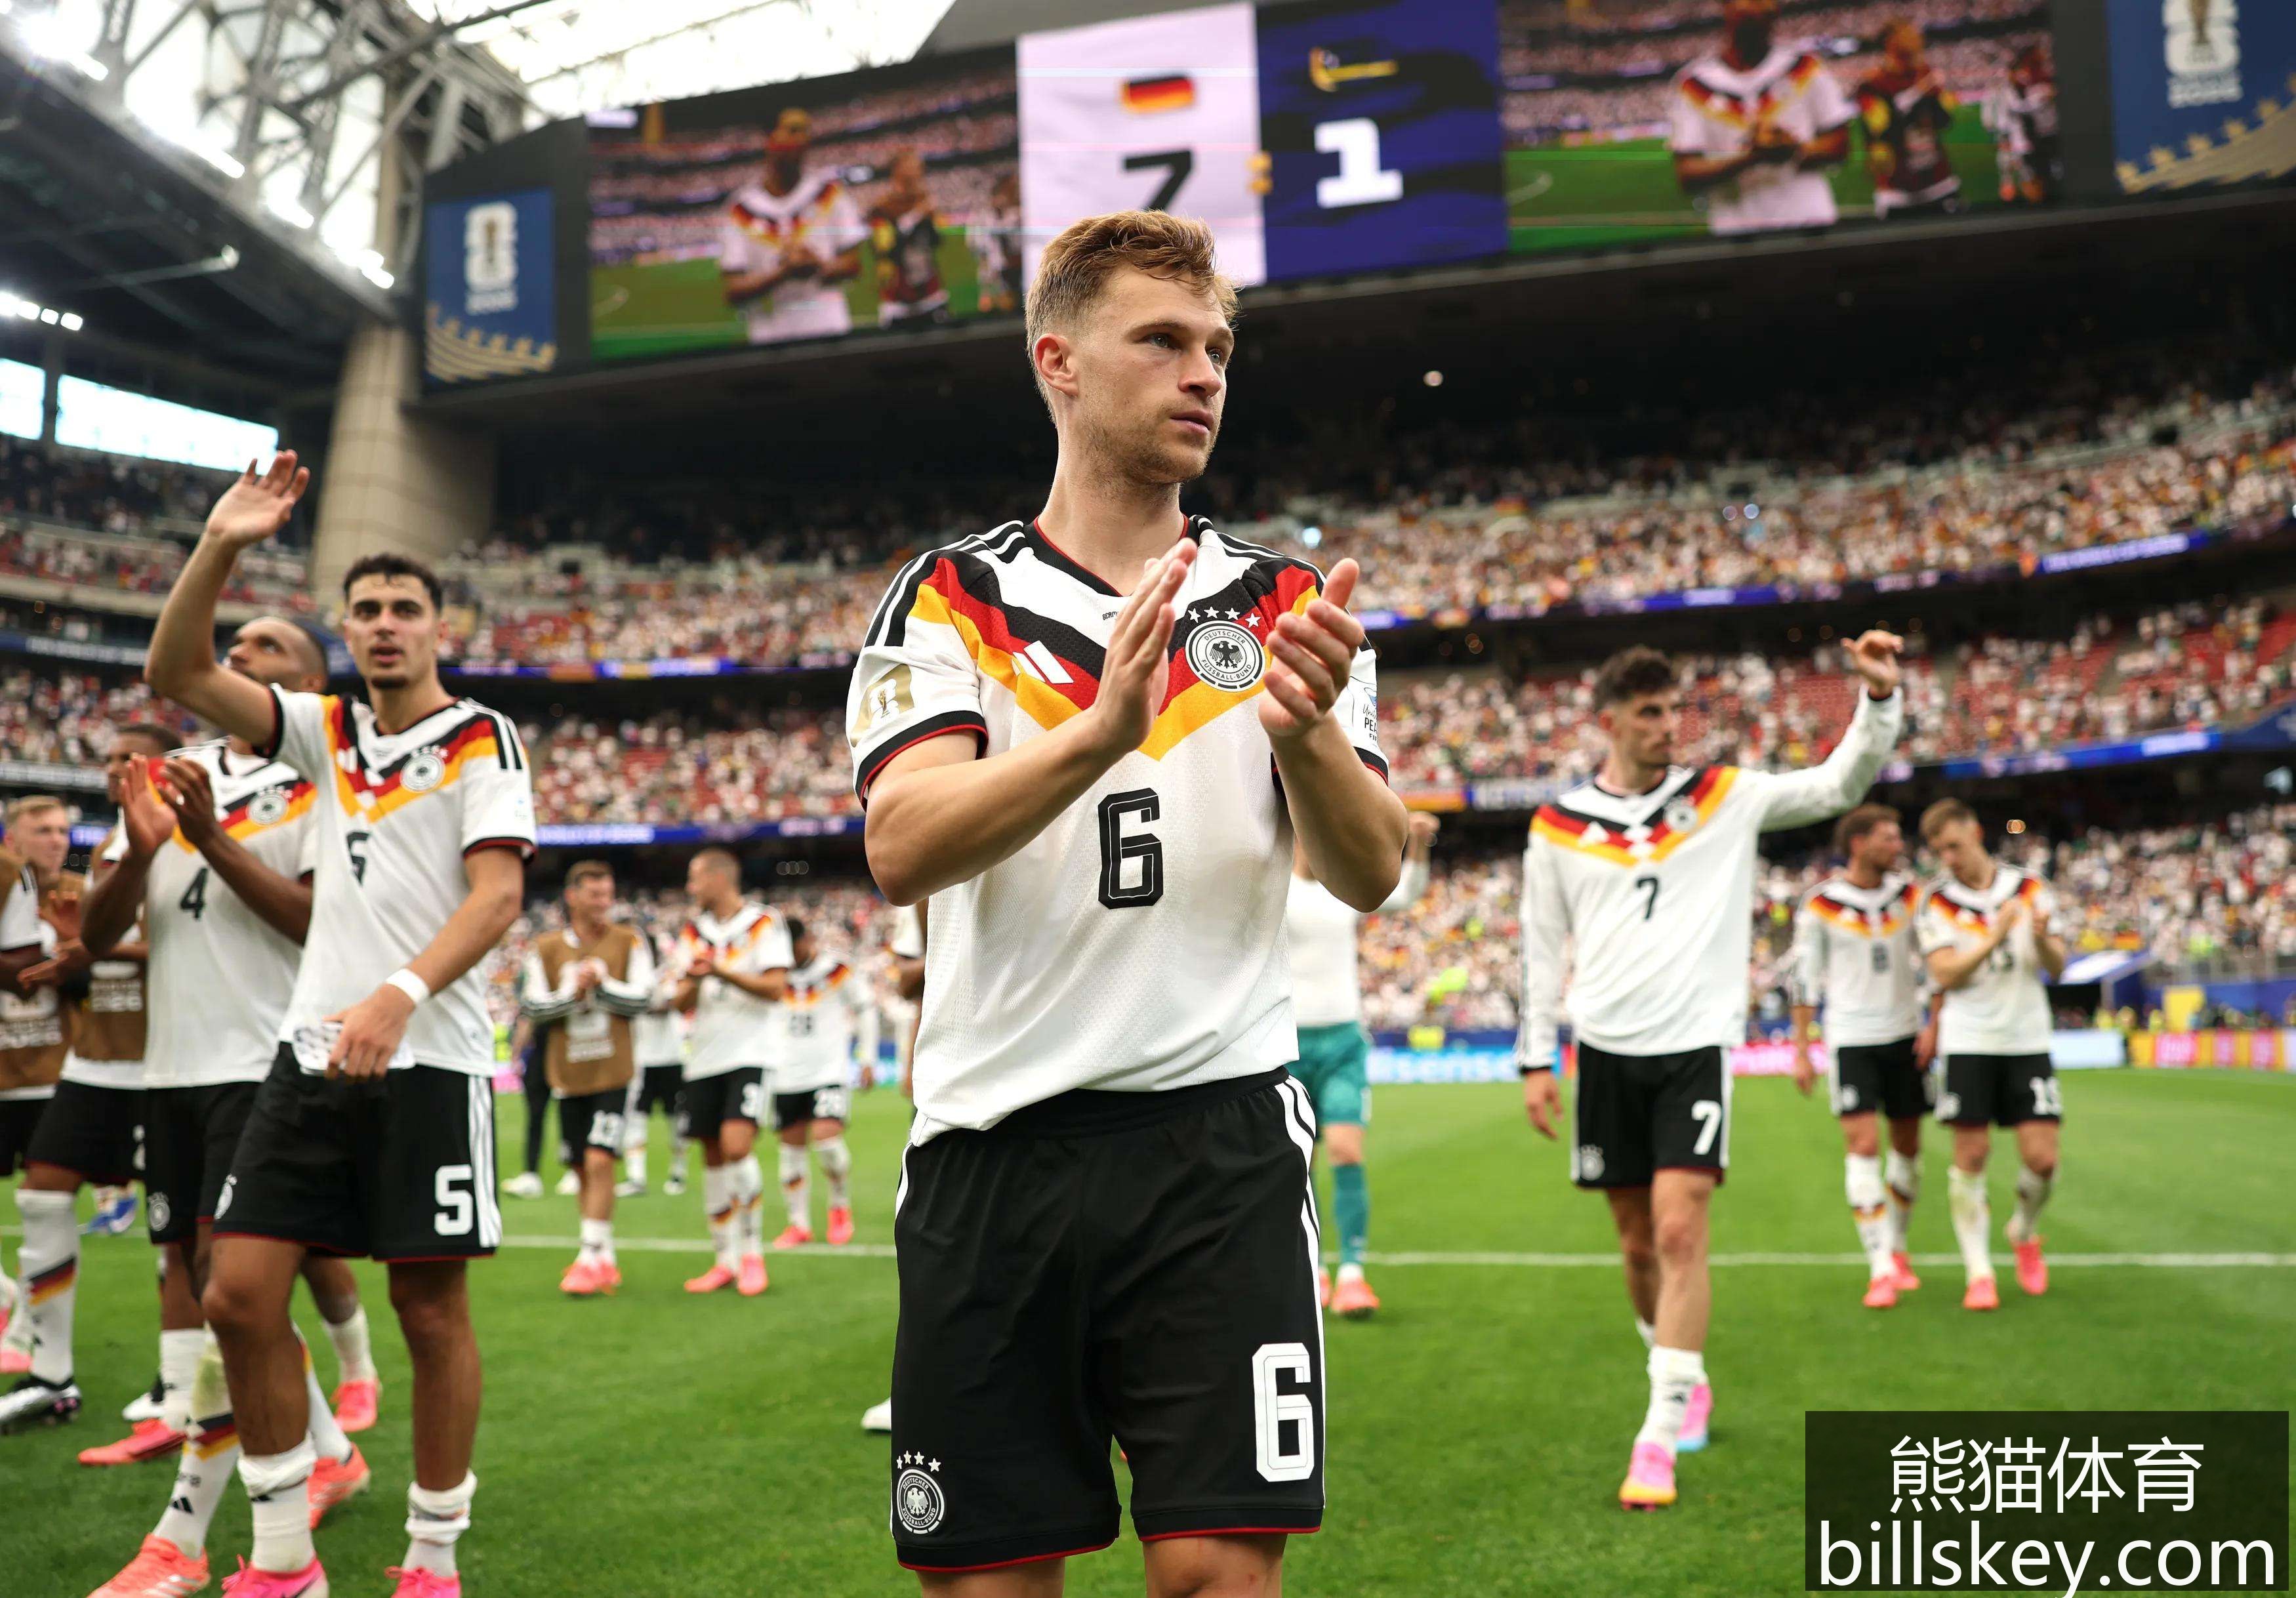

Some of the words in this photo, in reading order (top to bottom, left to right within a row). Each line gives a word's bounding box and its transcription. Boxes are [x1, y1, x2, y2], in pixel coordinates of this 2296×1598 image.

[1122, 149, 1194, 211] 7
[1314, 117, 1403, 209] 1
[1204, 630, 1246, 644] DEUTSCHER
[1200, 659, 1252, 680] FUSSBALL-BUND
[1098, 788, 1164, 910] 6
[180, 867, 209, 921] 4
[1635, 874, 1660, 921] 7
[1691, 1099, 1723, 1156] 7
[434, 1164, 474, 1236] 5
[1252, 1343, 1315, 1483] 6
[902, 1477, 930, 1490] DEUTSCHER
[902, 1507, 936, 1526] FUSSBALL-BUND
